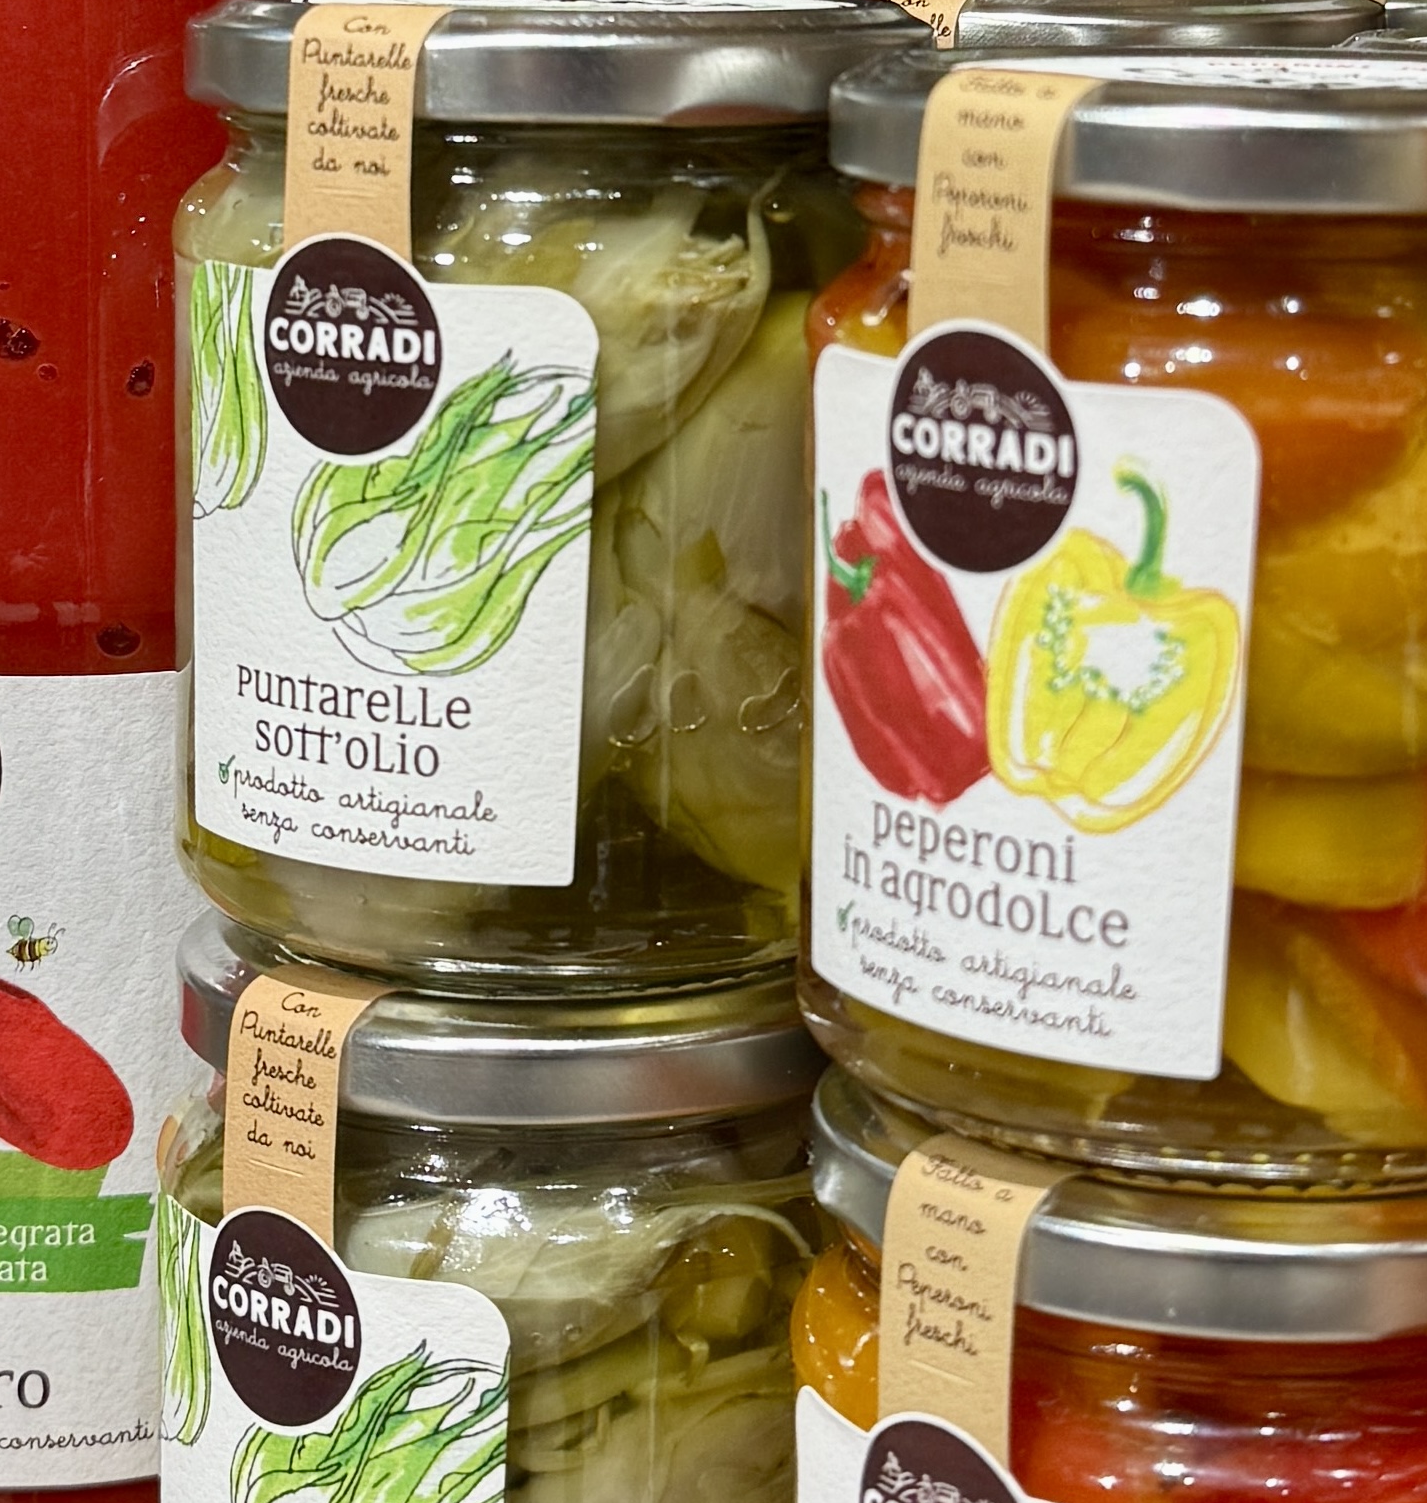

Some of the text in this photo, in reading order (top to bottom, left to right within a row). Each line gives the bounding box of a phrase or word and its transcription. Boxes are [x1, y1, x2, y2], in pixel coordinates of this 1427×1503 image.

[343, 16, 390, 35] Con
[302, 37, 412, 71] Puntarelle
[317, 72, 391, 114] fresche
[307, 107, 400, 140] coltivate
[312, 145, 392, 176] da noi
[269, 316, 435, 365] CORRADI
[273, 360, 434, 396] azienda agricola
[891, 411, 1074, 478] CORRADI
[234, 765, 497, 829] prodotto artigianale
[241, 802, 476, 856] senza conservanti
[871, 799, 1077, 884] peperoni
[842, 833, 1130, 948] in agrodolce
[851, 916, 1137, 1001] prodotto artigianale
[281, 992, 322, 1017] Con
[859, 954, 1113, 1038] senza conservanti
[240, 1009, 337, 1059] Puntarelle
[251, 1047, 317, 1090] fresche
[243, 1084, 325, 1126] coltivate
[247, 1118, 316, 1160] da noi
[918, 1201, 987, 1235] mano
[212, 1275, 355, 1348] CORRADI
[897, 1261, 993, 1321] Peperoni
[215, 1319, 354, 1372] azienda agricola
[904, 1302, 980, 1356] freschi
